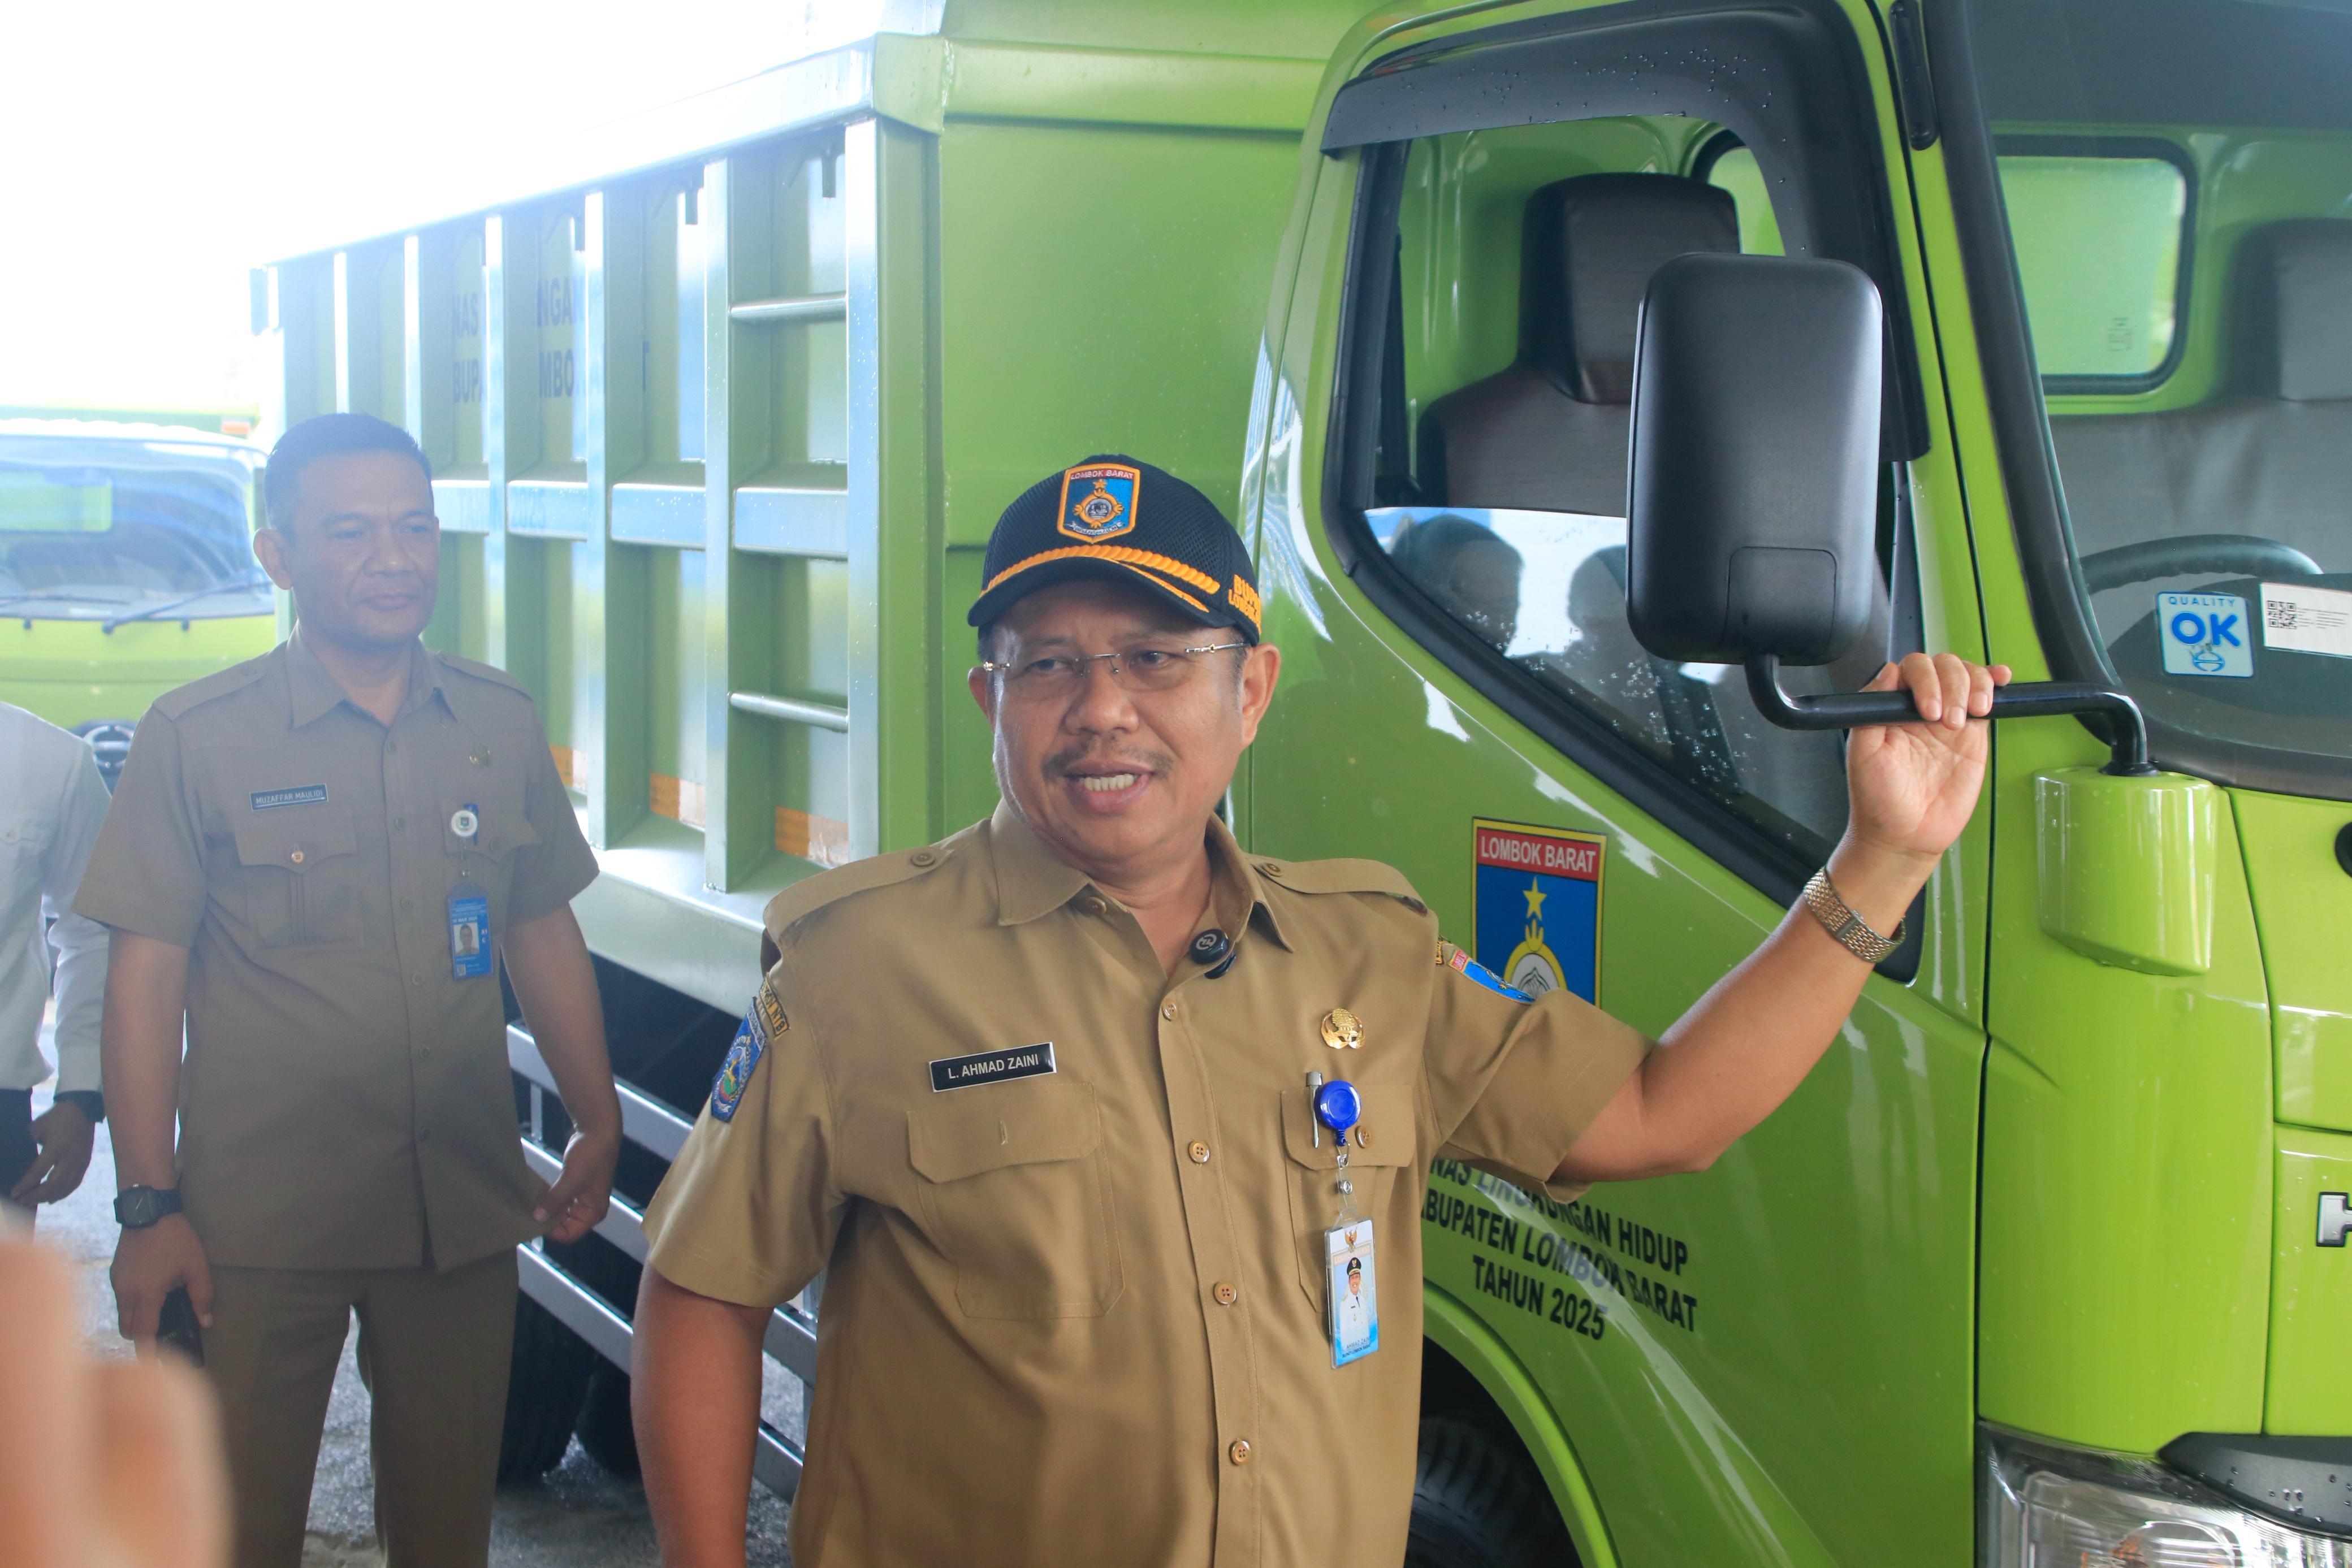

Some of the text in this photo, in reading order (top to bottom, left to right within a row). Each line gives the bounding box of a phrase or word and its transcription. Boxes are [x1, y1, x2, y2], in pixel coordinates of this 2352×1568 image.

[1071, 469, 1134, 480] LOMBOK BARAT
[2168, 596, 2236, 608] QUALITY
[2171, 611, 2240, 647] OK
[256, 792, 293, 804] MUZAFFAR
[1481, 835, 1597, 873] LOMBOK BARAT
[948, 1053, 1039, 1080] L. AHMAD ZAINI
[1421, 1188, 1698, 1332] BUPATEN LOMBOK BARAT
[1618, 1217, 1688, 1276] HIDUP
[1472, 1254, 1608, 1341] TAHUN 2025
